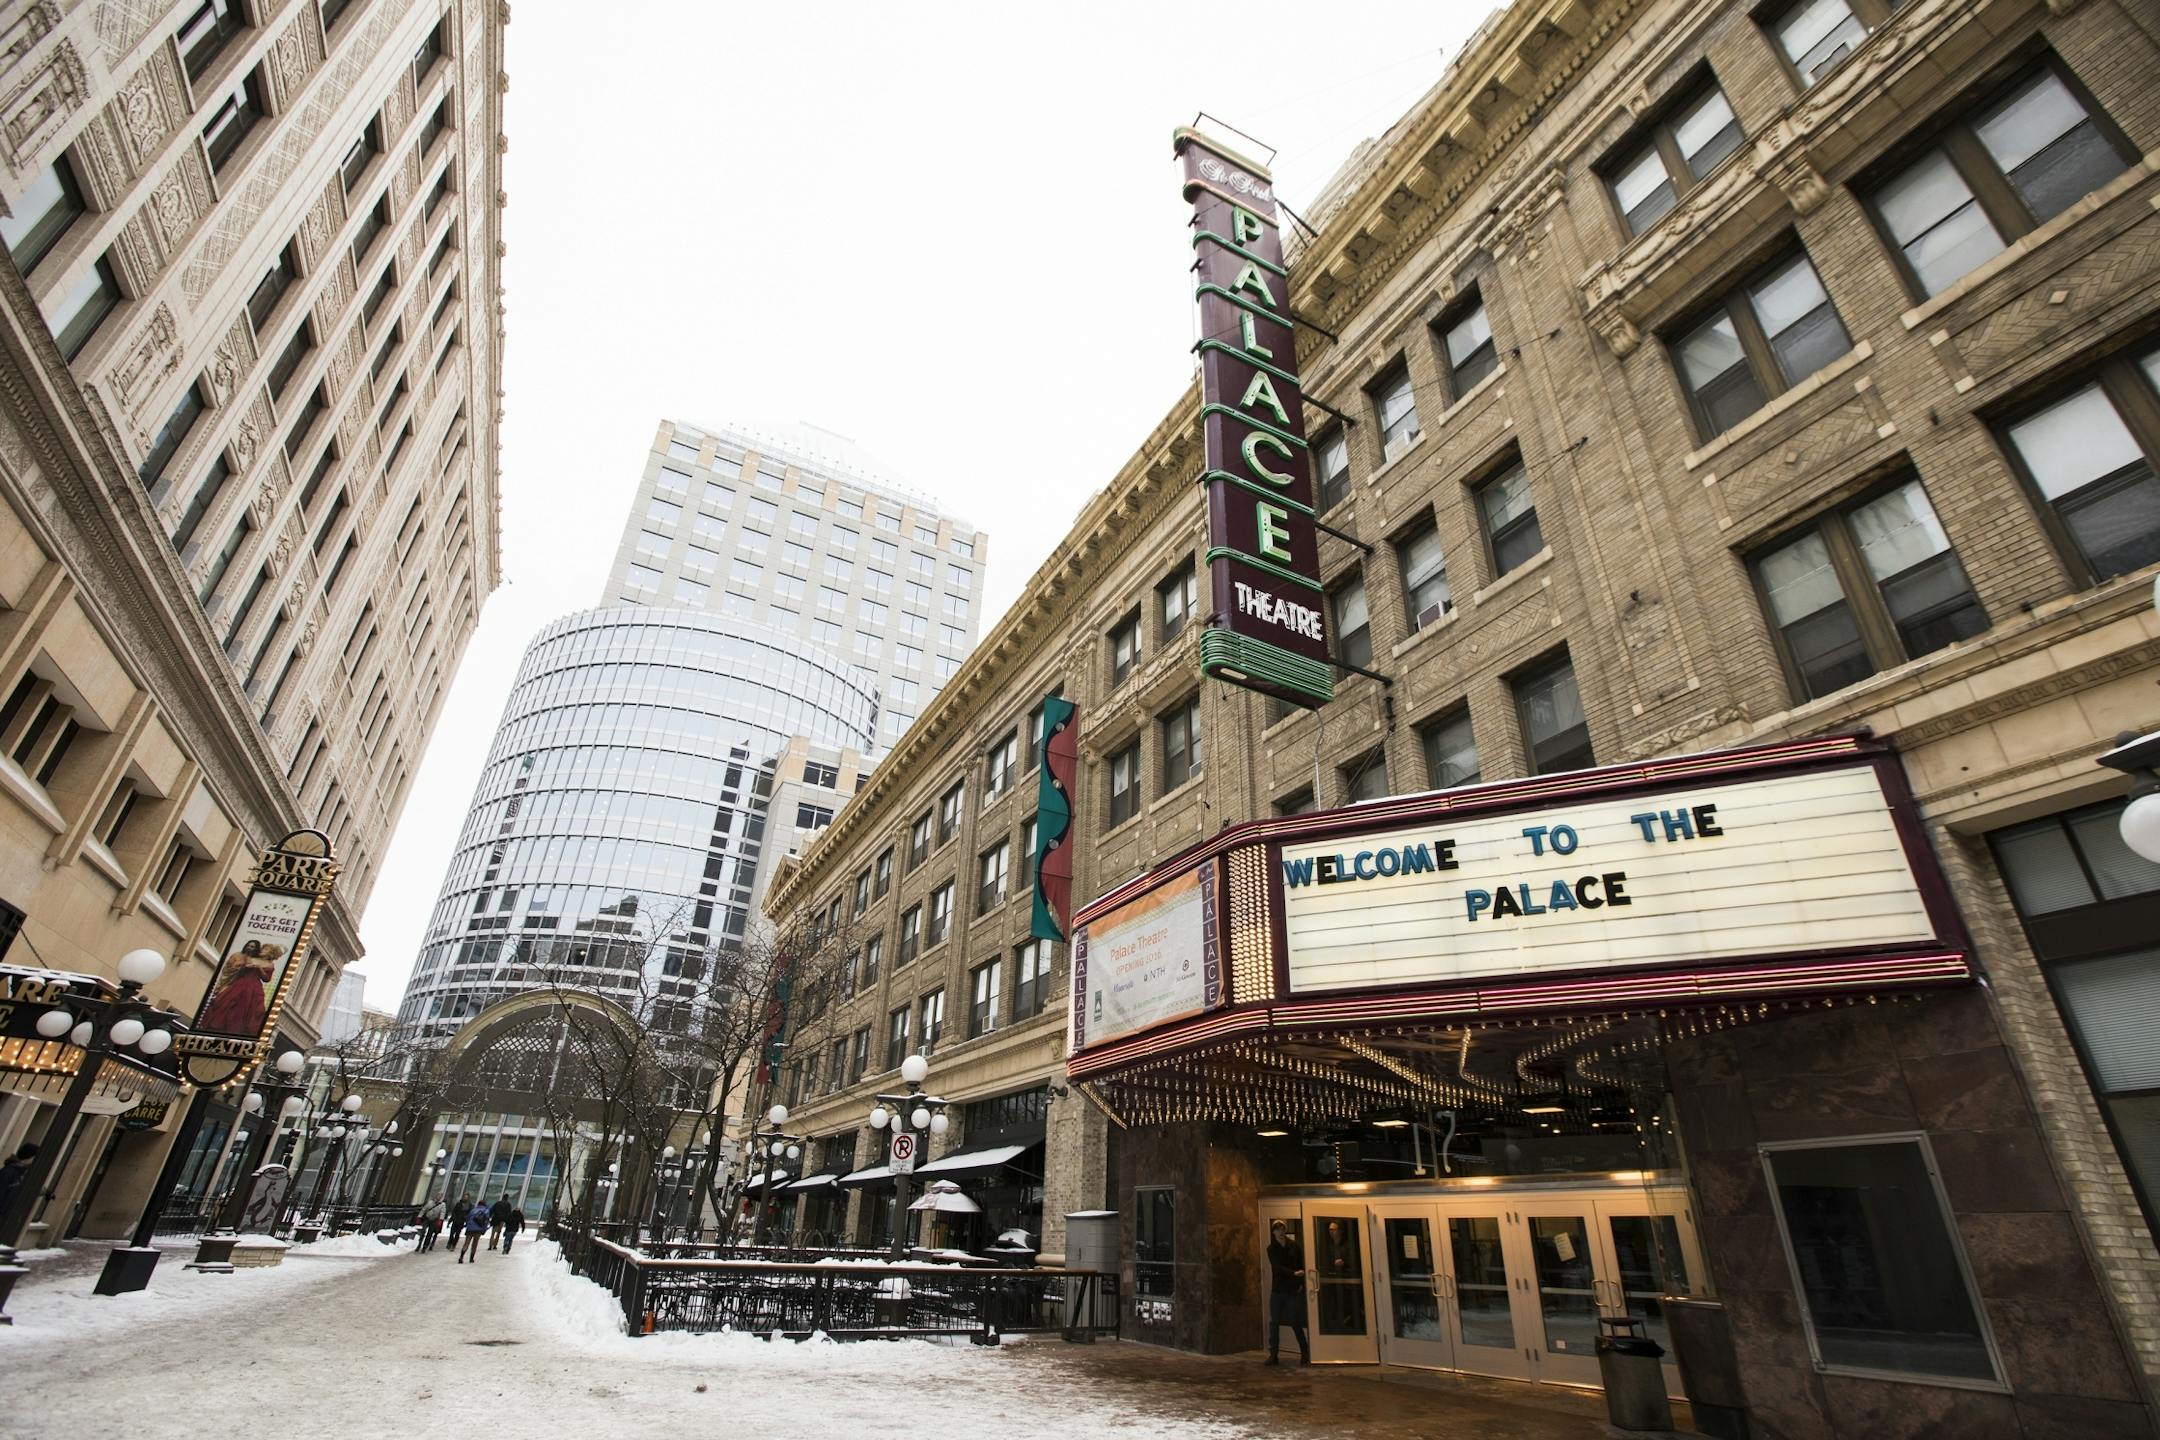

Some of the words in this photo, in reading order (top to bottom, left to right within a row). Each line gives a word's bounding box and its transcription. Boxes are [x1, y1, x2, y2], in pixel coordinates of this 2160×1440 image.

[1229, 206, 1296, 563] PALACE
[1235, 581, 1323, 641] THEATRE
[256, 851, 337, 880] PARK
[1282, 839, 1459, 889] WELCOME
[1522, 824, 1579, 857] TO
[1631, 803, 1724, 843] THE
[248, 869, 333, 894] SQUARE
[1465, 871, 1632, 922] PALACE
[247, 921, 296, 934] TOGETHER
[250, 913, 278, 924] LET'S
[279, 918, 299, 927] GET
[1110, 942, 1136, 961] Palace
[1138, 927, 1169, 950] Theatre
[1205, 883, 1217, 1002] PALACE
[1076, 946, 1085, 1045] PALACE
[172, 1034, 269, 1058] THEATRE
